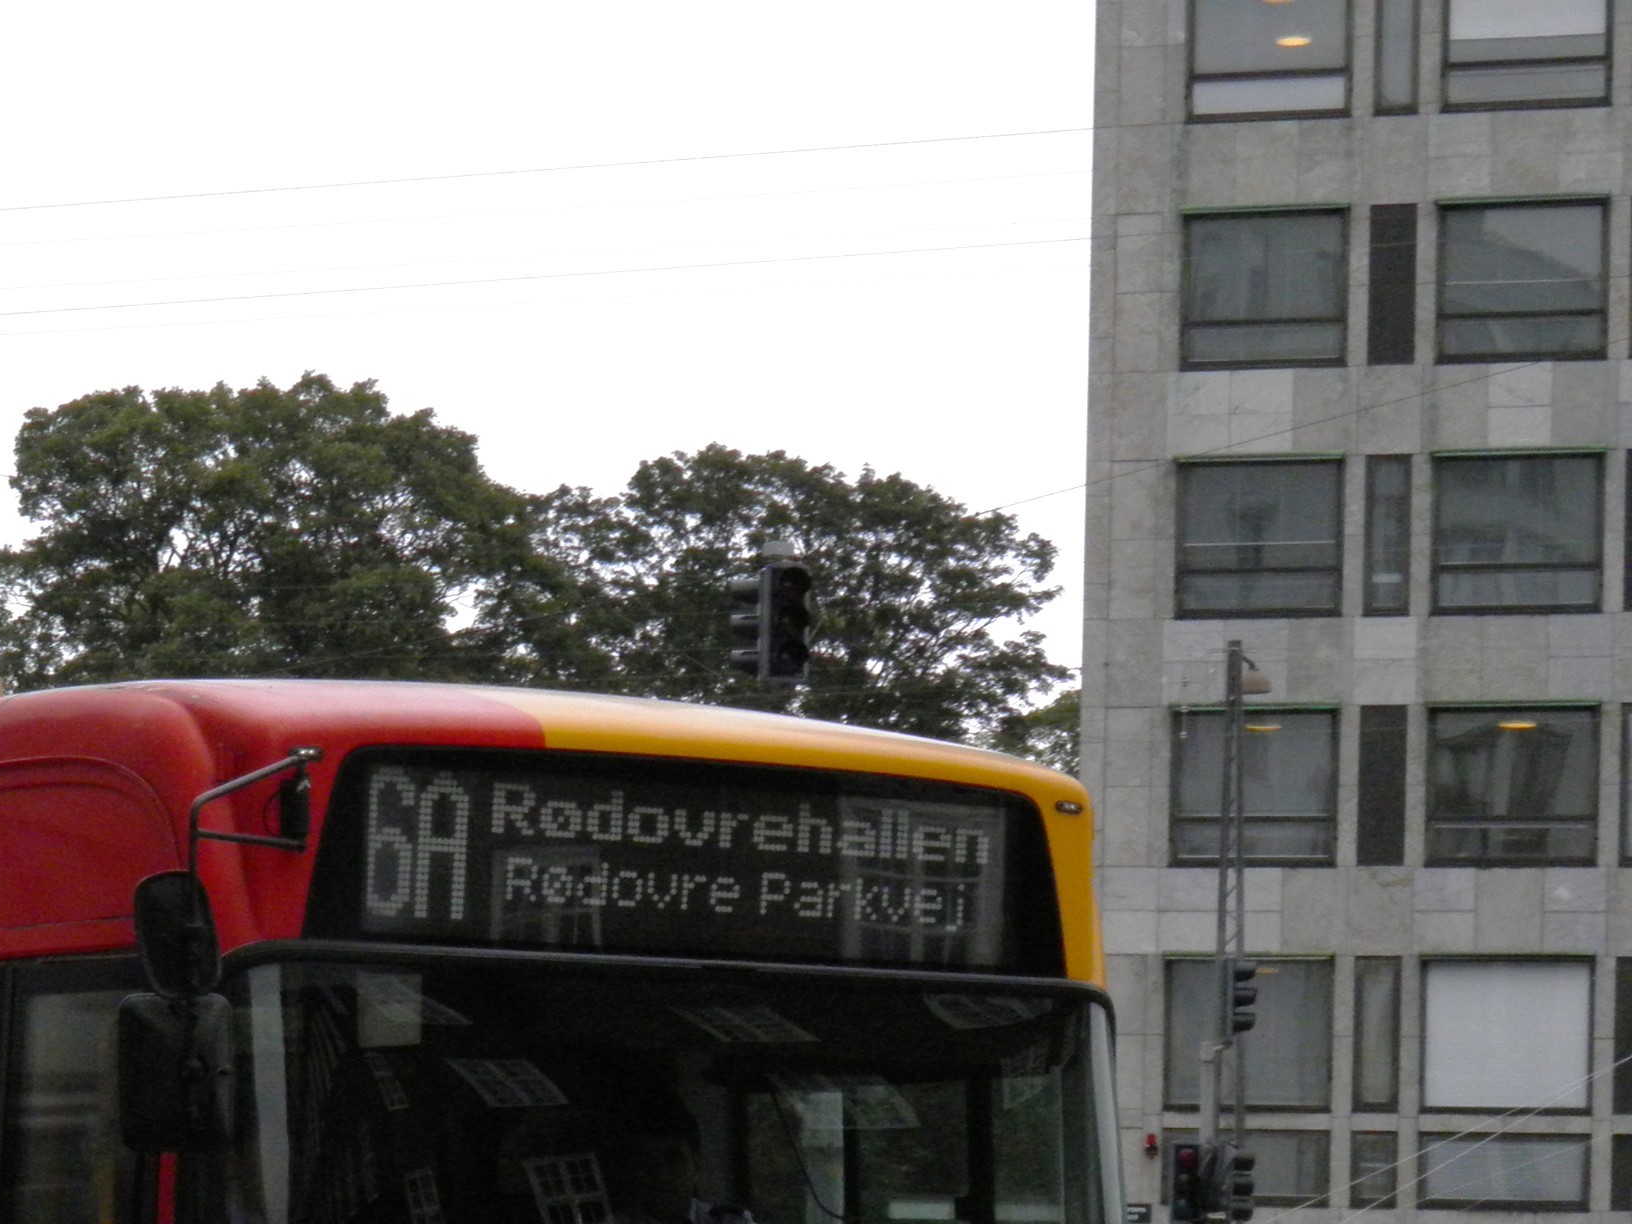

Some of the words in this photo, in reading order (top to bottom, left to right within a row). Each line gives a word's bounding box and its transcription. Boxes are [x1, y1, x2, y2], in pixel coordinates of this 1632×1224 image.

[366, 766, 469, 920] 6A
[490, 780, 992, 867] Rødovrehallen
[503, 855, 744, 919] Rødovre
[757, 871, 968, 933] Parkvej
